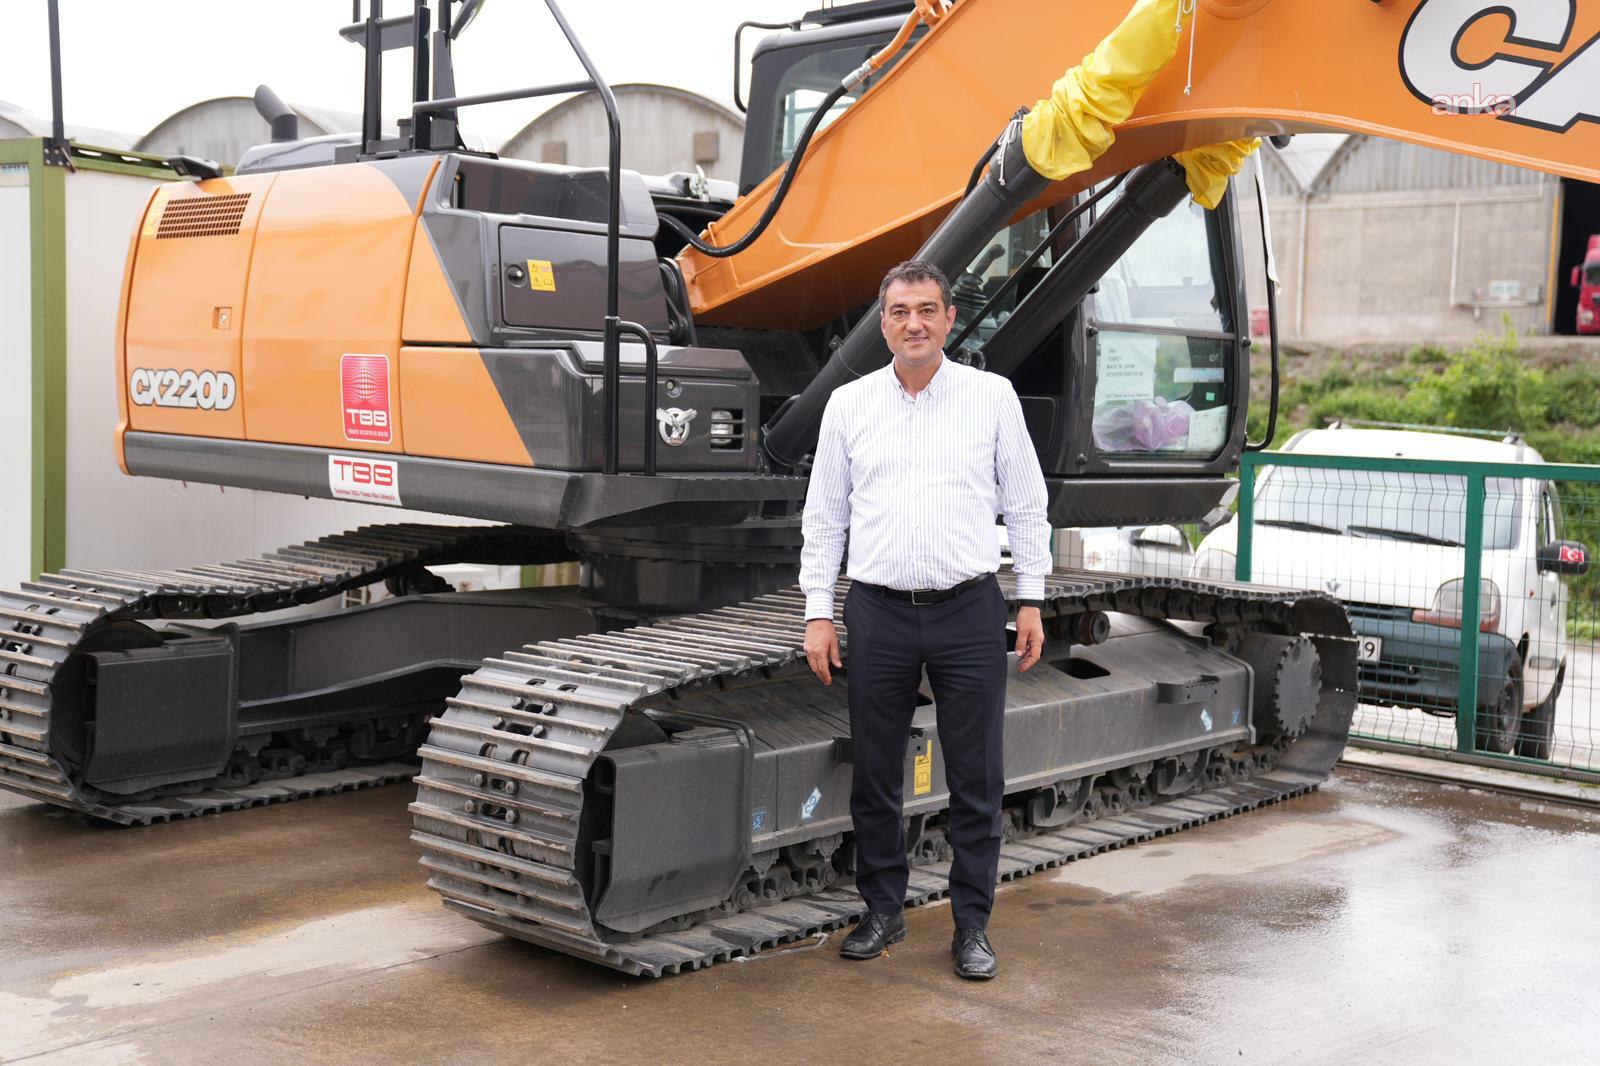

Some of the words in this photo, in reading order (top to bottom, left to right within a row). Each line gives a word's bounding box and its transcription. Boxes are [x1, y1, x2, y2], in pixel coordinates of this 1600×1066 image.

[130, 368, 236, 411] CX220D
[346, 408, 388, 427] TBB
[333, 460, 393, 487] TBB
[1358, 642, 1375, 657] 9
